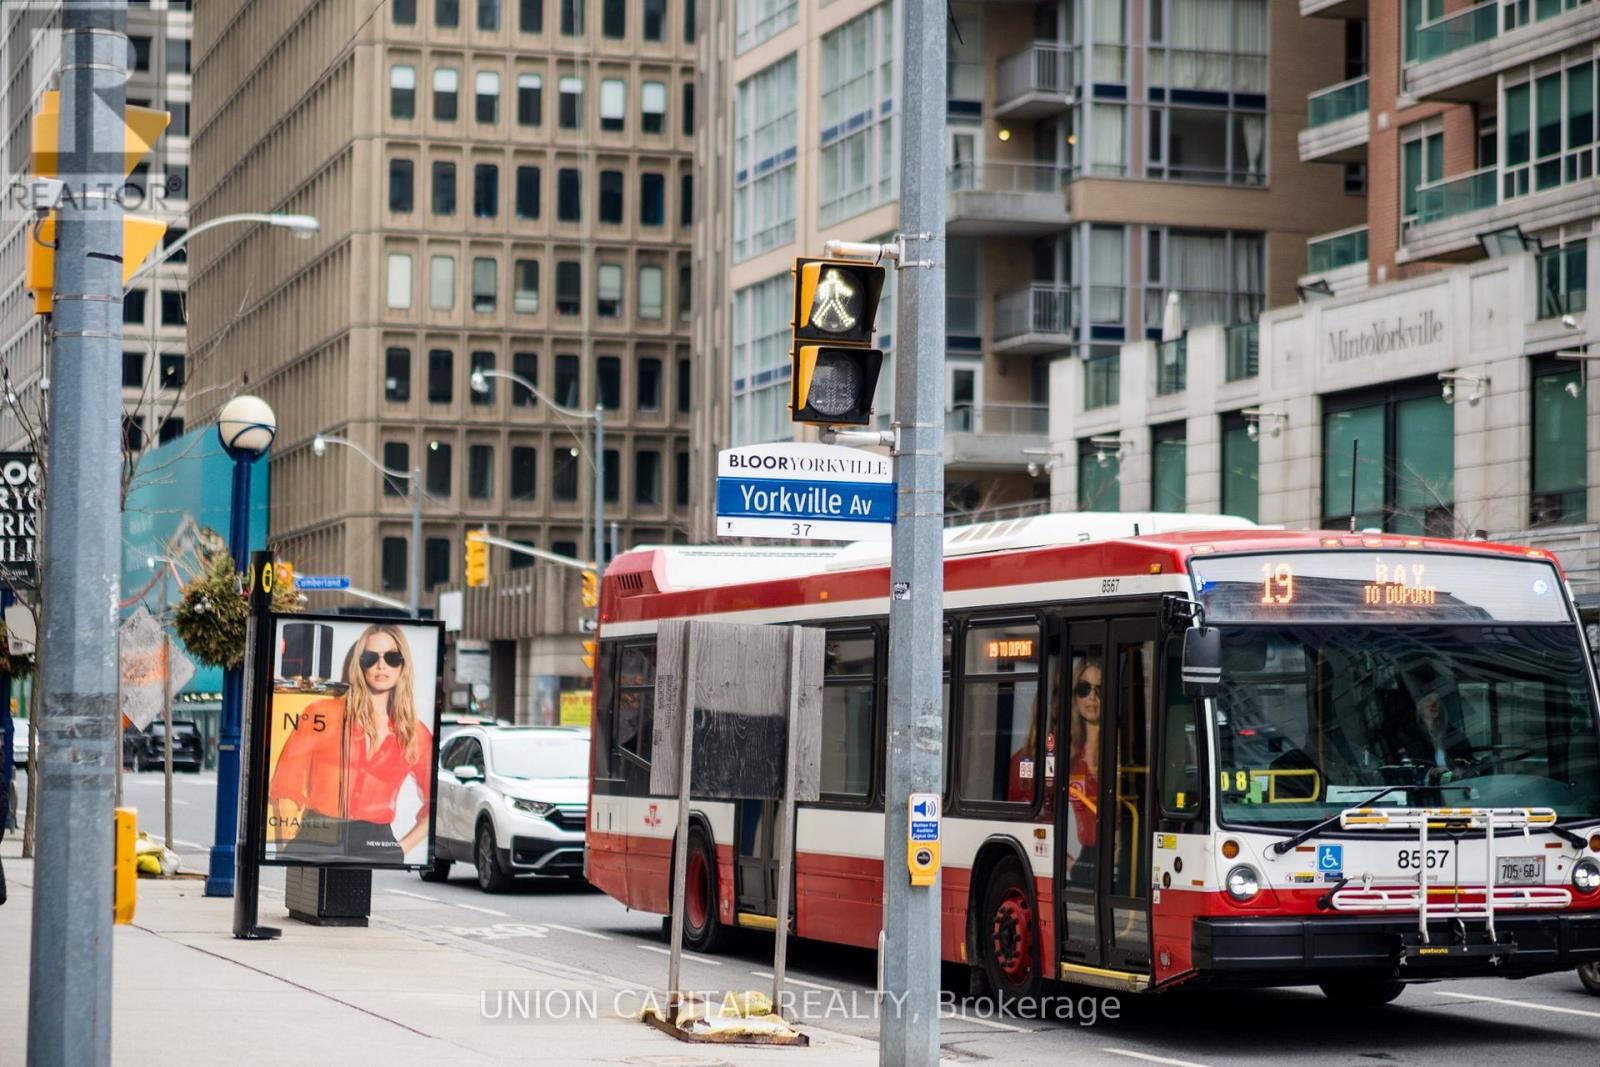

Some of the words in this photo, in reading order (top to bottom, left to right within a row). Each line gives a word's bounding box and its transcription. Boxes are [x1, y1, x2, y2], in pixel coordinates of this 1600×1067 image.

[741, 484, 842, 514] Yorkville
[850, 495, 872, 515] Av
[791, 523, 812, 536] 37
[1102, 579, 1120, 593] 8567
[1261, 562, 1294, 604] 19
[1375, 563, 1425, 585] BAY
[1364, 585, 1380, 604] TO
[1386, 585, 1436, 604] DUPONT
[268, 817, 330, 830] CHANEL
[1397, 849, 1449, 869] 8567
